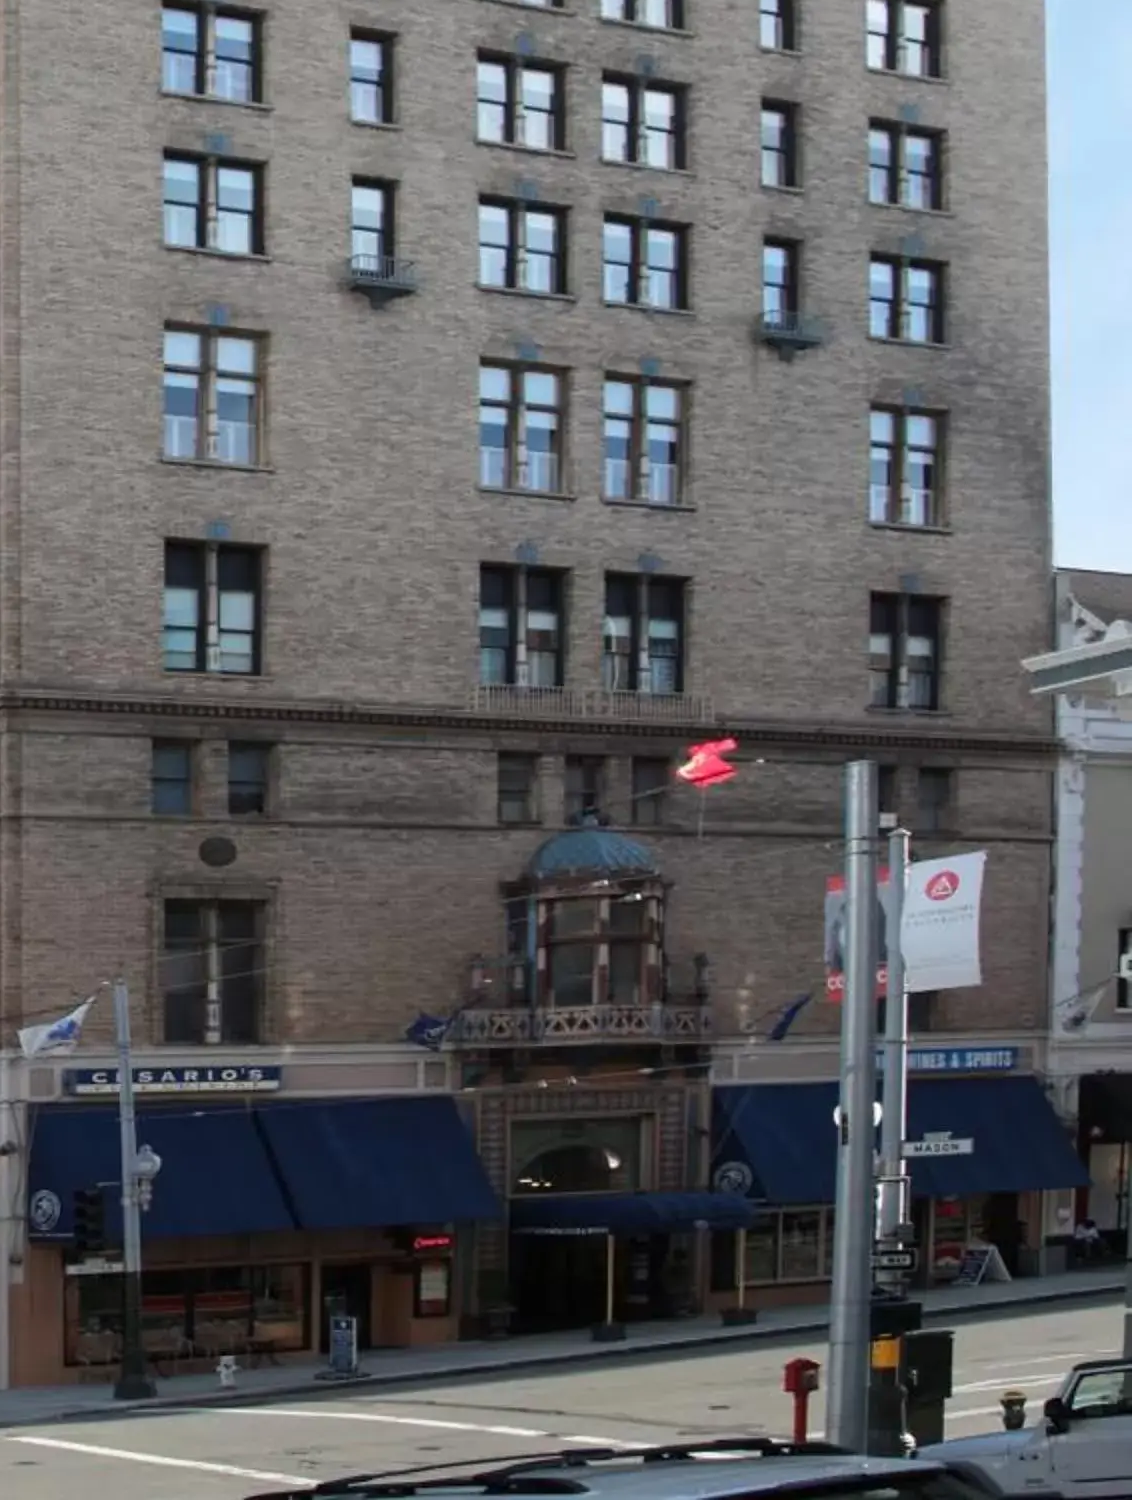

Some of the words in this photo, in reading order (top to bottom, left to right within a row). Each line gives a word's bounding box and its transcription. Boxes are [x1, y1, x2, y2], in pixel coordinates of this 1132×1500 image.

[965, 1051, 1013, 1069] SPIRITS
[91, 1067, 263, 1084] CSARIO'S
[913, 1142, 960, 1153] MASON
